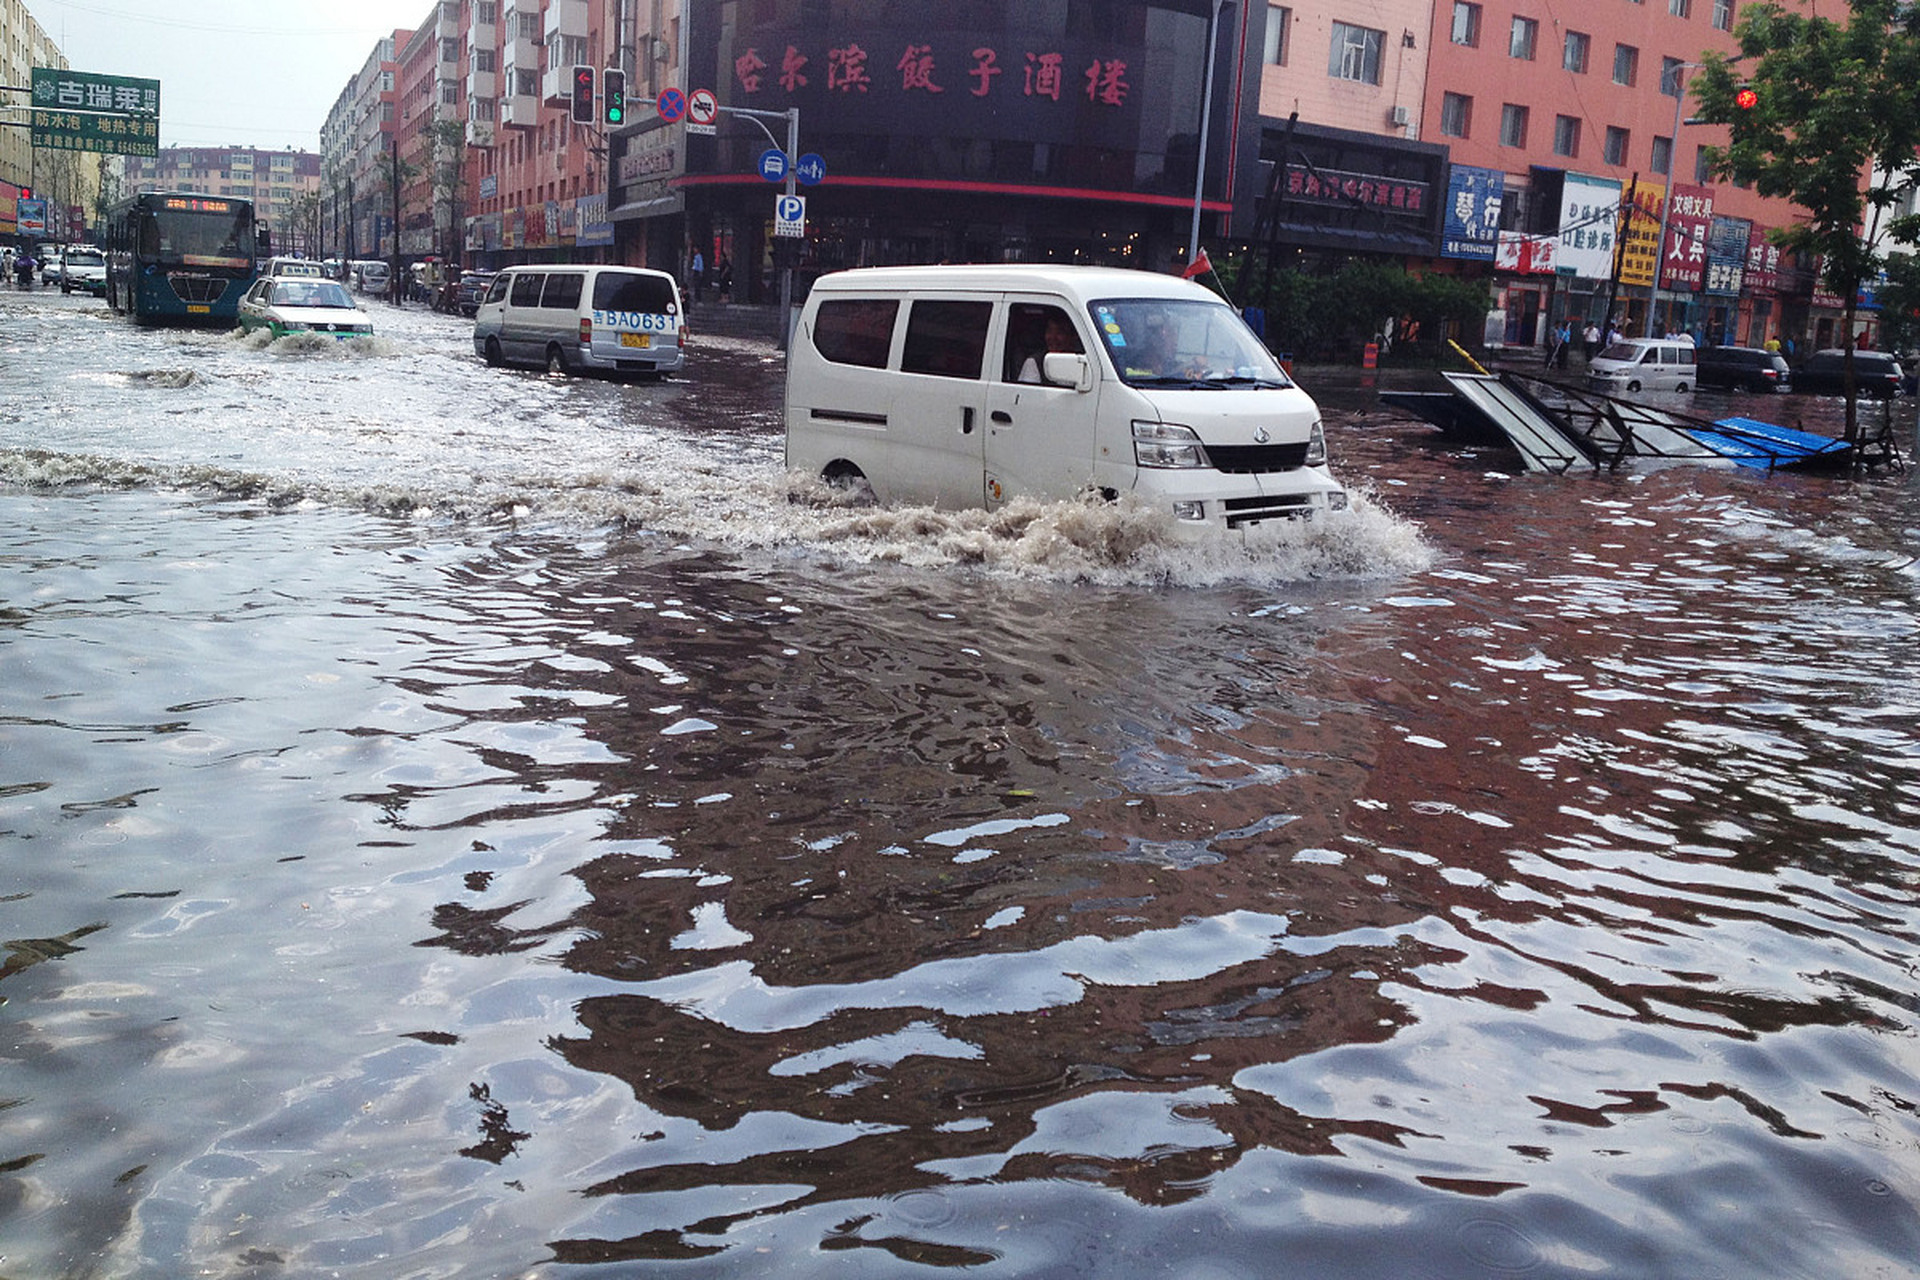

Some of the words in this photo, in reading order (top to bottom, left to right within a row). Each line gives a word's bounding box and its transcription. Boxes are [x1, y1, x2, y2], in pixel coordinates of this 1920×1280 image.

[58, 81, 140, 110] 吉瑞莱
[1669, 221, 1705, 263] 文具
[593, 309, 675, 330] 吉BA0631
